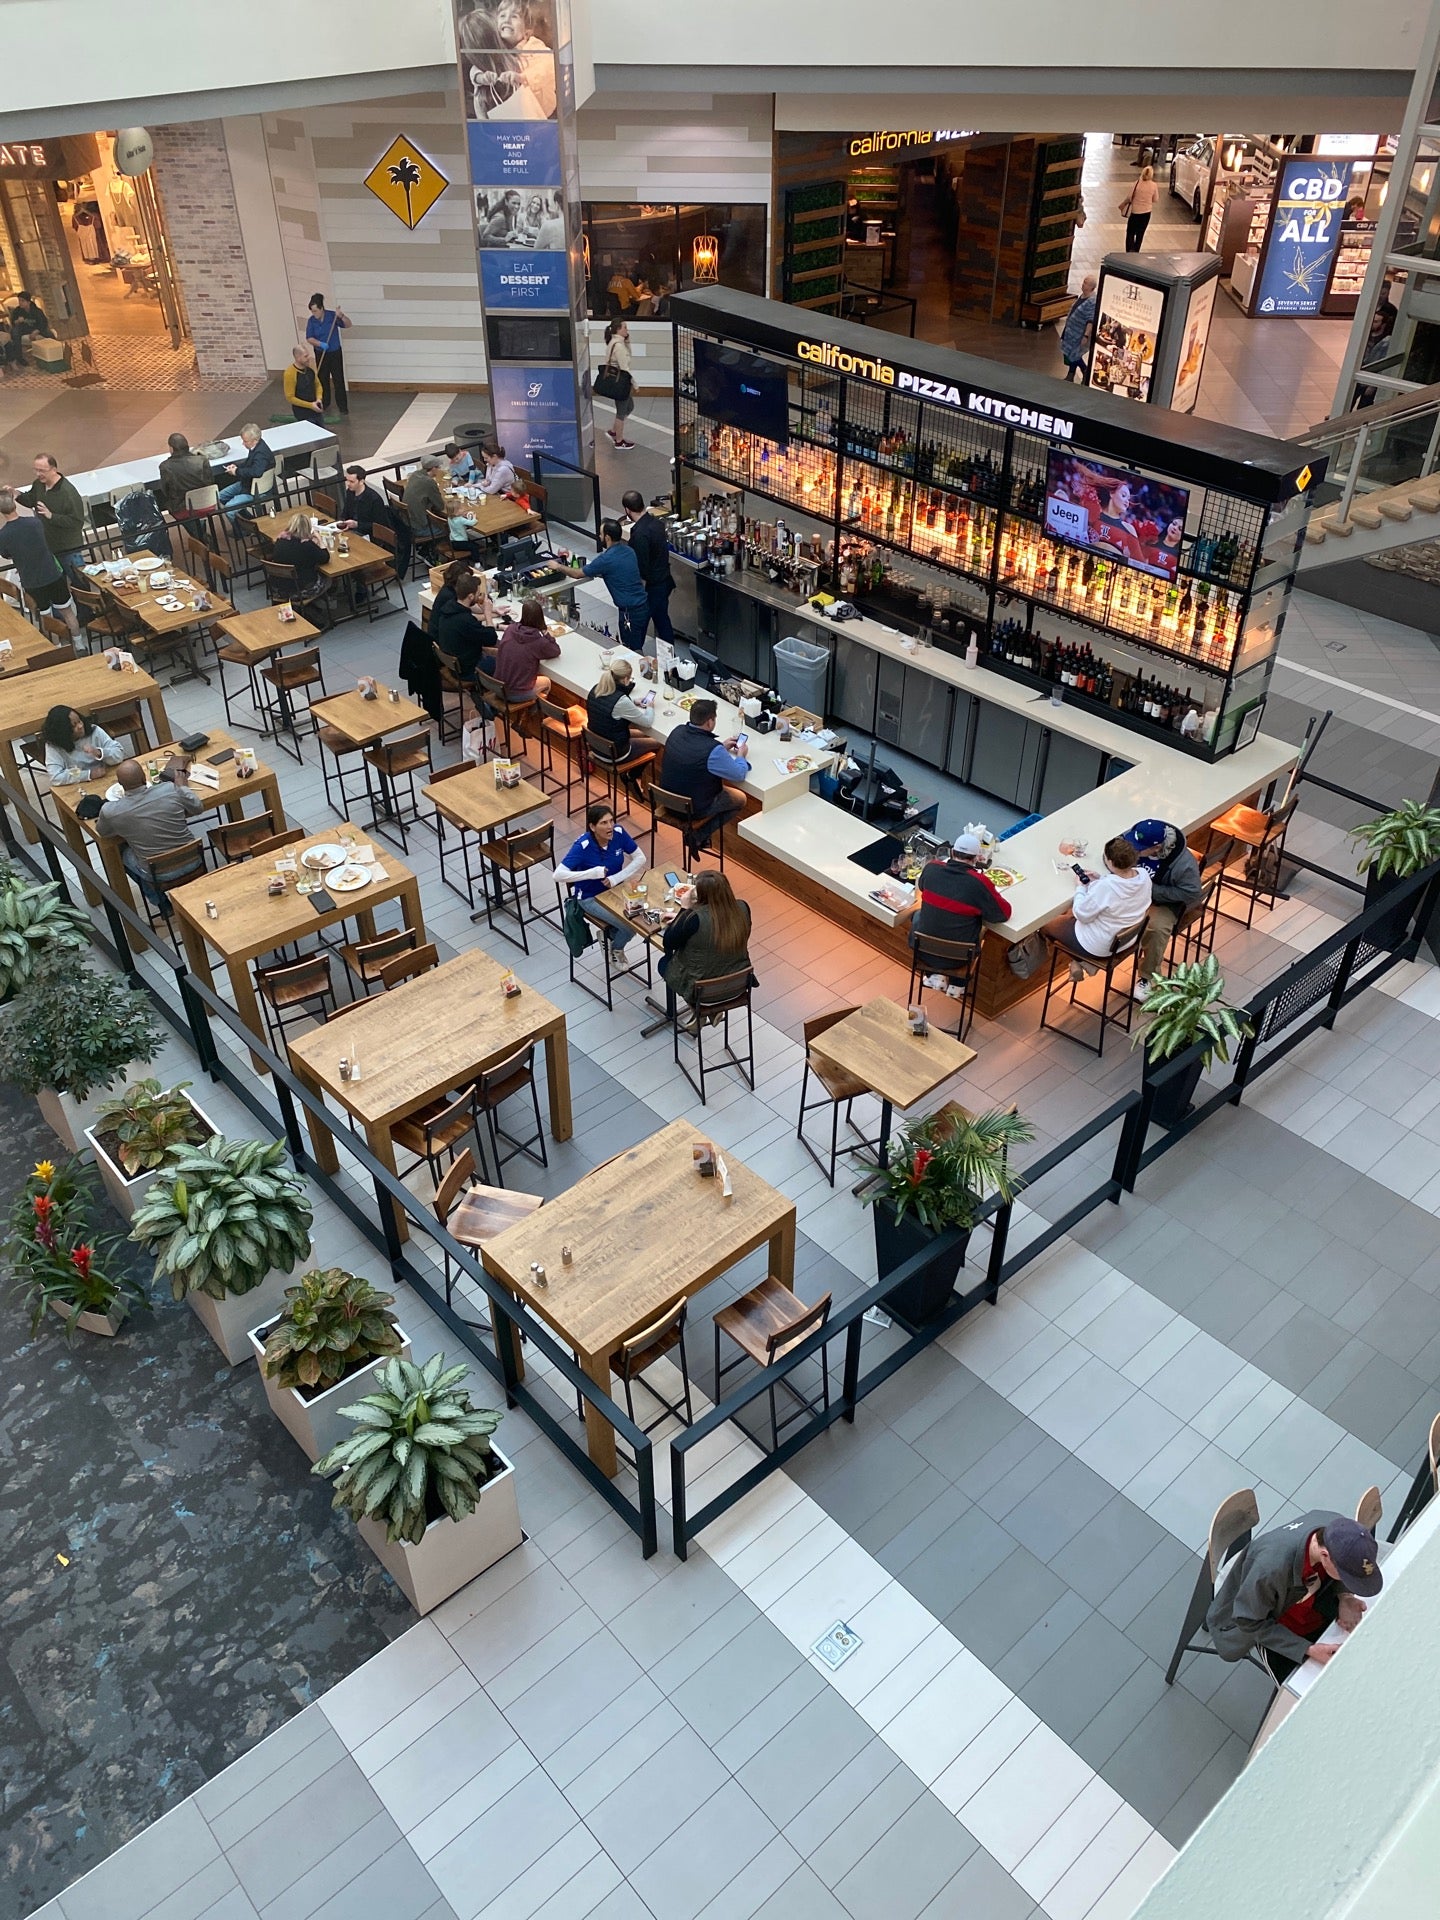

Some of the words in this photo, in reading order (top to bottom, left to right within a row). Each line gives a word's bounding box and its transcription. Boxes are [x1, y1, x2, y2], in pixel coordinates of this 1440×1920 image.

[850, 130, 932, 156] california
[1288, 178, 1343, 200] CBD
[1279, 219, 1330, 243] ALL
[513, 263, 535, 273] EAT
[500, 275, 550, 285] DESSERT
[511, 287, 541, 297] FIRST
[797, 341, 894, 385] california
[898, 371, 962, 405] PIZZA
[968, 392, 1074, 439] KITCHEN
[1052, 505, 1079, 524] Jeep
